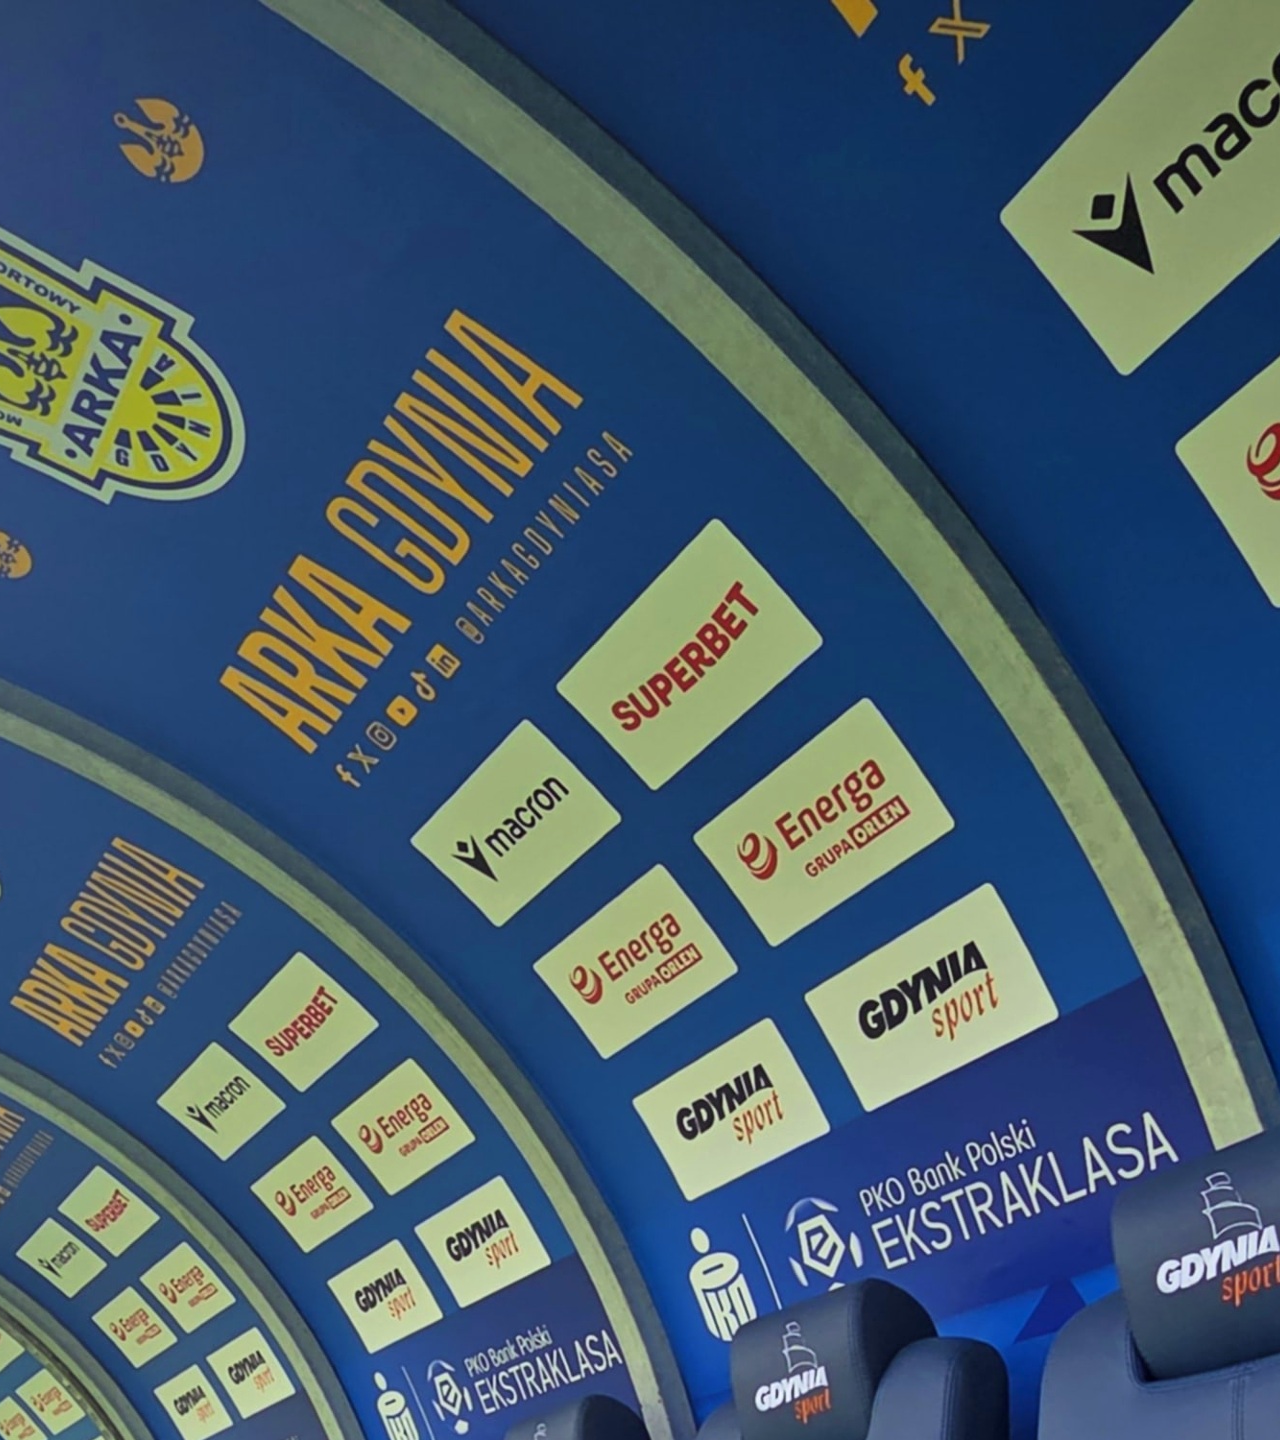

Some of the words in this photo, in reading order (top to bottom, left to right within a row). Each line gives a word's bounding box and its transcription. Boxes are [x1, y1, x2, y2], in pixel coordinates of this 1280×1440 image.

[62, 330, 142, 457] ARKA
[220, 554, 413, 754] ARKA
[325, 308, 584, 595] GDYNIA
[611, 581, 759, 732] SUPERBET
[485, 775, 569, 858] macron
[774, 759, 886, 852] Energa
[803, 839, 854, 879] GRUPA
[853, 799, 906, 848] ORLEN
[60, 836, 206, 972] GDYNIA
[597, 912, 682, 982] Energa
[624, 973, 661, 1005] GRUPA
[658, 945, 700, 984] ORLEN
[10, 942, 130, 1048] ARKA
[265, 984, 339, 1058] SUPERBET
[857, 941, 988, 1040] GDYNIA
[931, 968, 1000, 1042] sport
[204, 1074, 251, 1119] macron
[376, 1092, 433, 1140] Energa
[676, 1063, 774, 1140] GDYNIA
[732, 1088, 784, 1146] sport
[289, 1165, 337, 1204] Energa
[860, 1177, 904, 1218] PKO
[909, 1151, 964, 1195] Bank
[966, 1119, 1037, 1174] Polski
[872, 1111, 1179, 1270] EKSTRAKLASA
[445, 1209, 510, 1263] GDYNIA
[485, 1230, 520, 1270] sport
[1156, 1225, 1280, 1295] GDYNIA
[354, 1268, 408, 1314] GDYNIA
[227, 1350, 266, 1385] GDYNIA
[464, 1356, 490, 1378] PKO
[490, 1339, 520, 1366] Bank
[517, 1324, 553, 1358] Polski
[474, 1329, 623, 1415] EKSTRAKLASA
[755, 1365, 829, 1412] GDYNIA
[794, 1388, 832, 1425] sport
